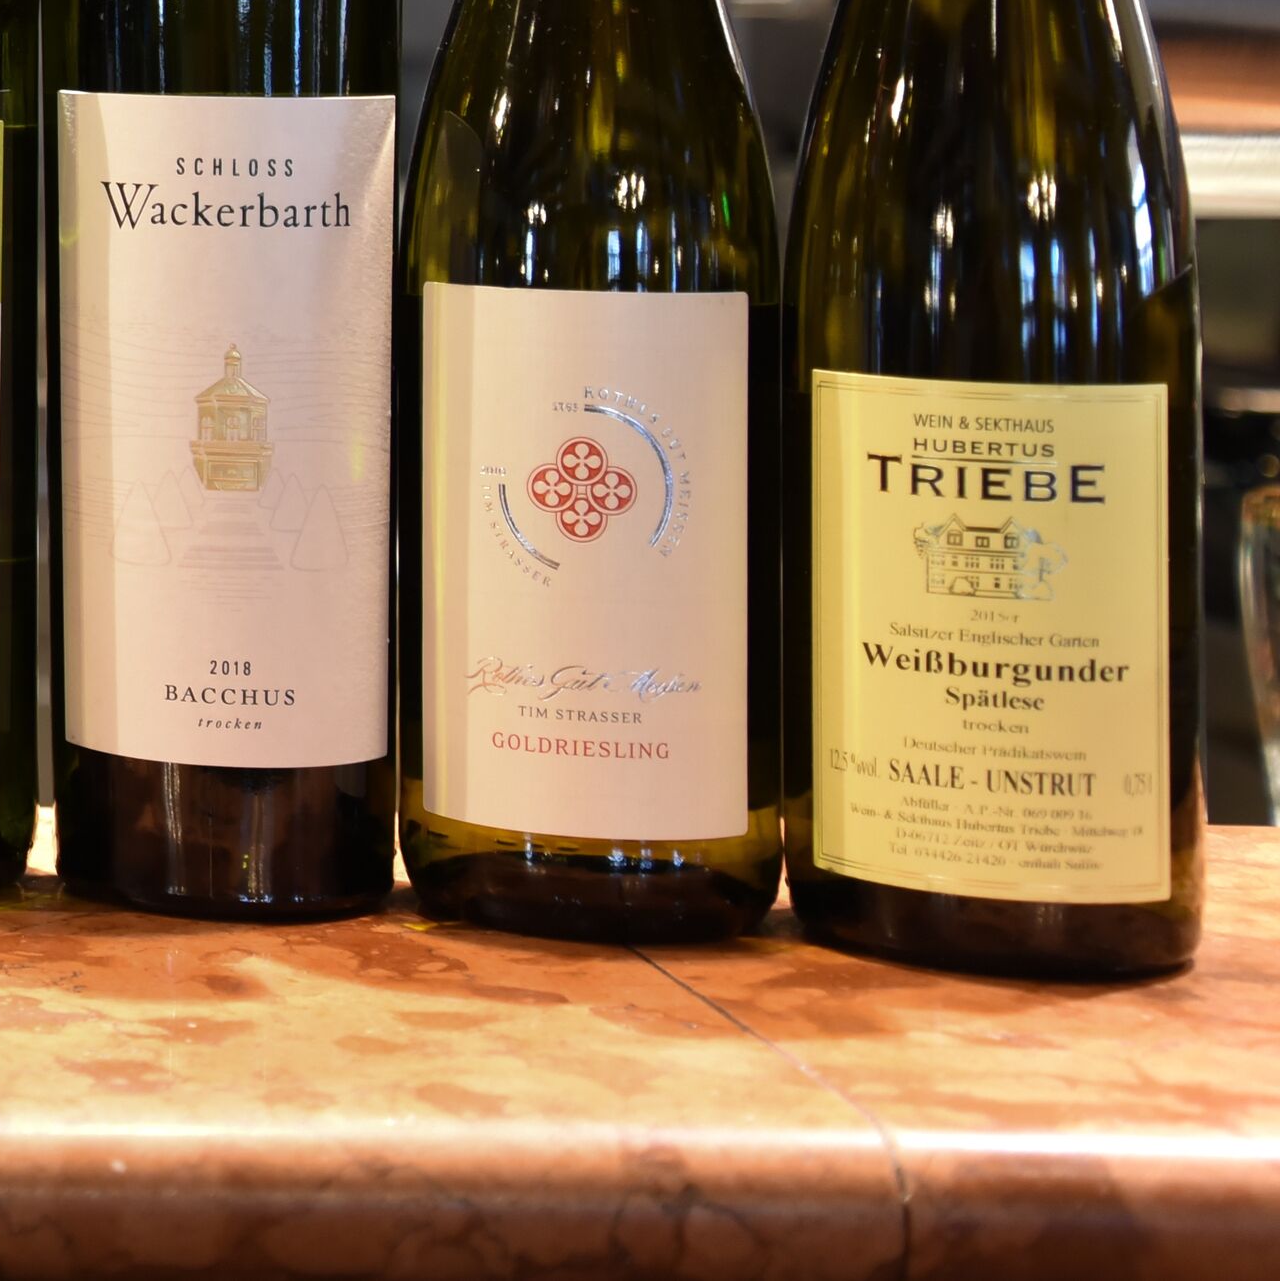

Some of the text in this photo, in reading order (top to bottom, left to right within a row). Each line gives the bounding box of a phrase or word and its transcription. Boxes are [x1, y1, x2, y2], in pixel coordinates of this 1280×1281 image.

[175, 156, 296, 179] SCHLOSS
[101, 181, 352, 230] Wackerbarth
[913, 413, 1055, 434] WEIN & SEKTHAUS
[912, 437, 1055, 458] HUBERTUS
[867, 451, 1106, 505] TRIEBE
[890, 621, 1100, 648] Salsitzer Englischer Garten
[209, 659, 252, 676] 2018
[862, 642, 1130, 688] Weißburgunder
[164, 683, 297, 707] BACCHUS
[945, 686, 1045, 711] Spätlese
[197, 716, 264, 731] trocken
[518, 705, 642, 724] TIM STRASSER
[962, 719, 1029, 734] trocken
[492, 732, 670, 760] GOLDRIESLING
[904, 736, 976, 755] Deutscher
[889, 758, 965, 790] SAALE
[986, 769, 1096, 797] UNSTRUT
